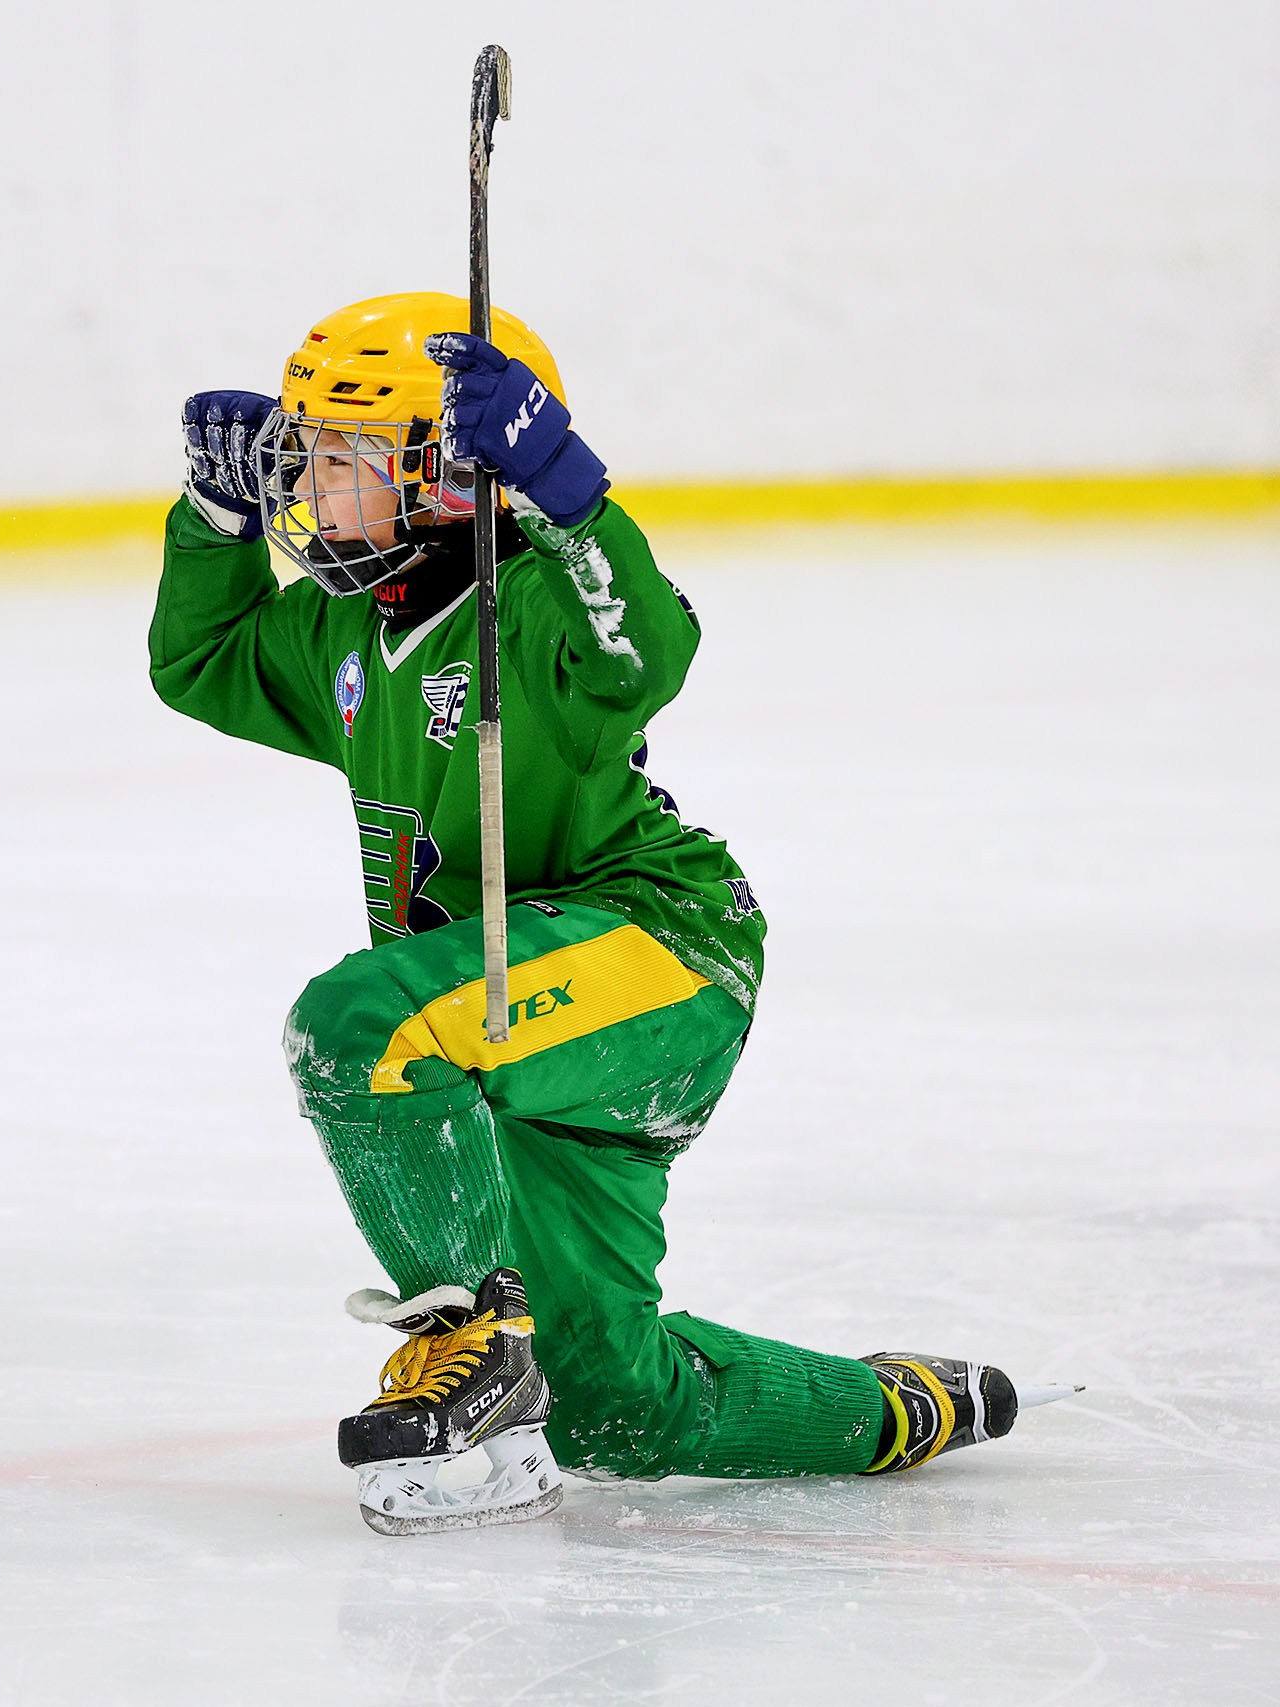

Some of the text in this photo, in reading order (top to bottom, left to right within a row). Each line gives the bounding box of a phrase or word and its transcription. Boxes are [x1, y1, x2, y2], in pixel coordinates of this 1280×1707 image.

[504, 380, 549, 449] CM
[393, 829, 412, 926] ВОДНИК
[483, 980, 575, 1039] TEX
[465, 1382, 504, 1420] CCM
